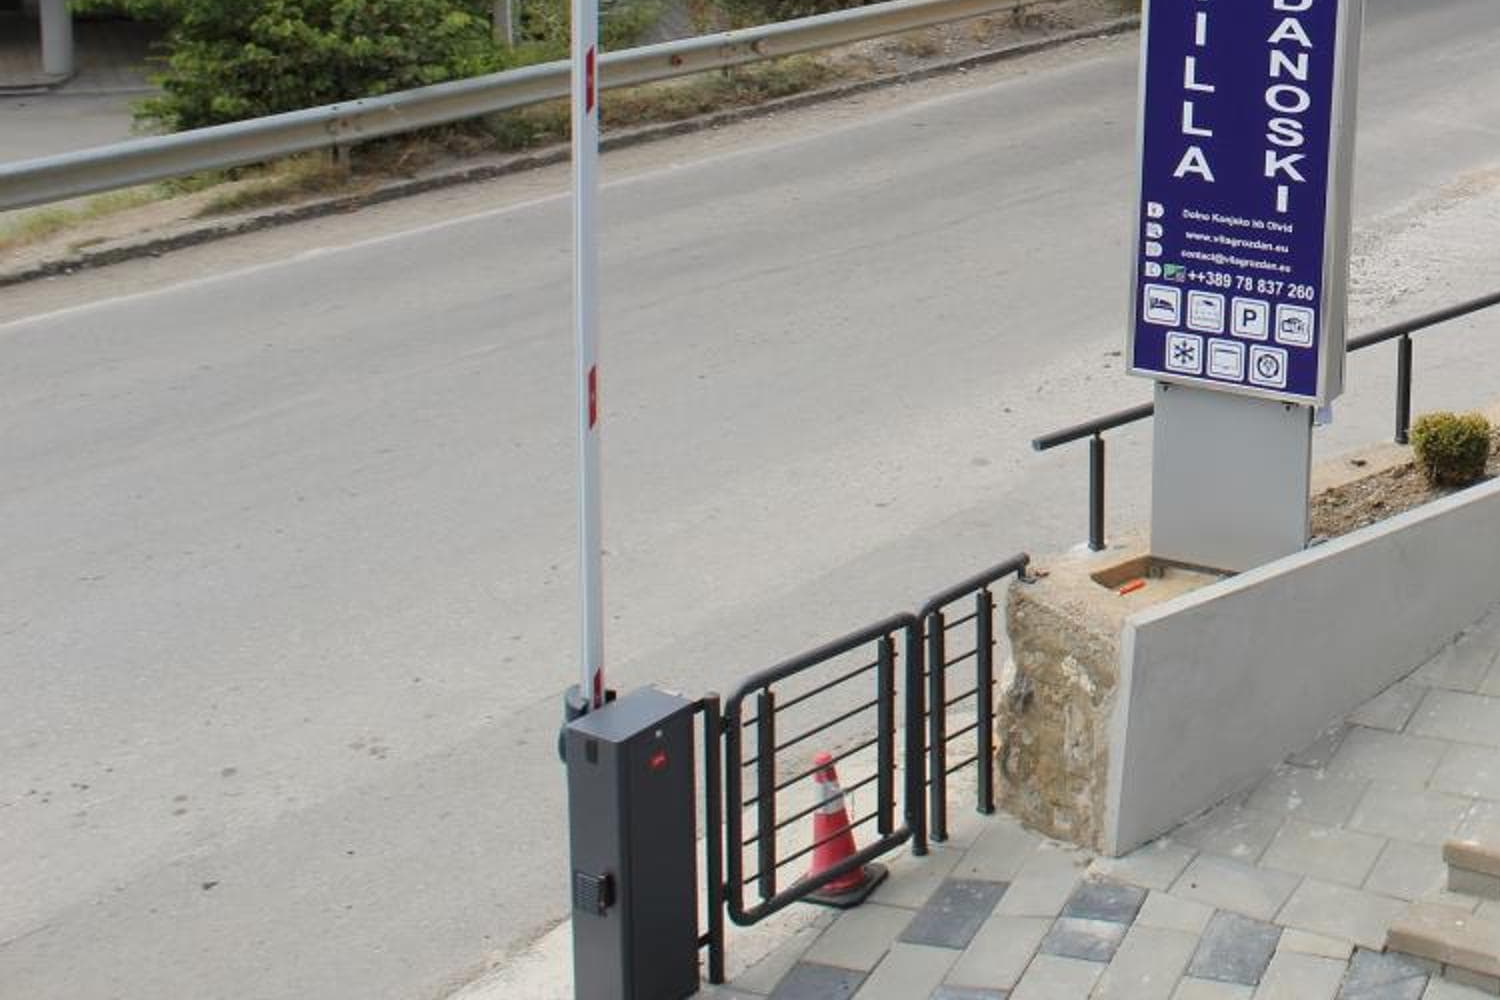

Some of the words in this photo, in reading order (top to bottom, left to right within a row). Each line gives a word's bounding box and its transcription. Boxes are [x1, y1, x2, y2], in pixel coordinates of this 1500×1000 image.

[1187, 269, 1232, 288] ++389
[1235, 275, 1254, 292] 78
[1257, 279, 1285, 296] 837
[1287, 283, 1315, 301] 260
[1242, 308, 1257, 327] P
